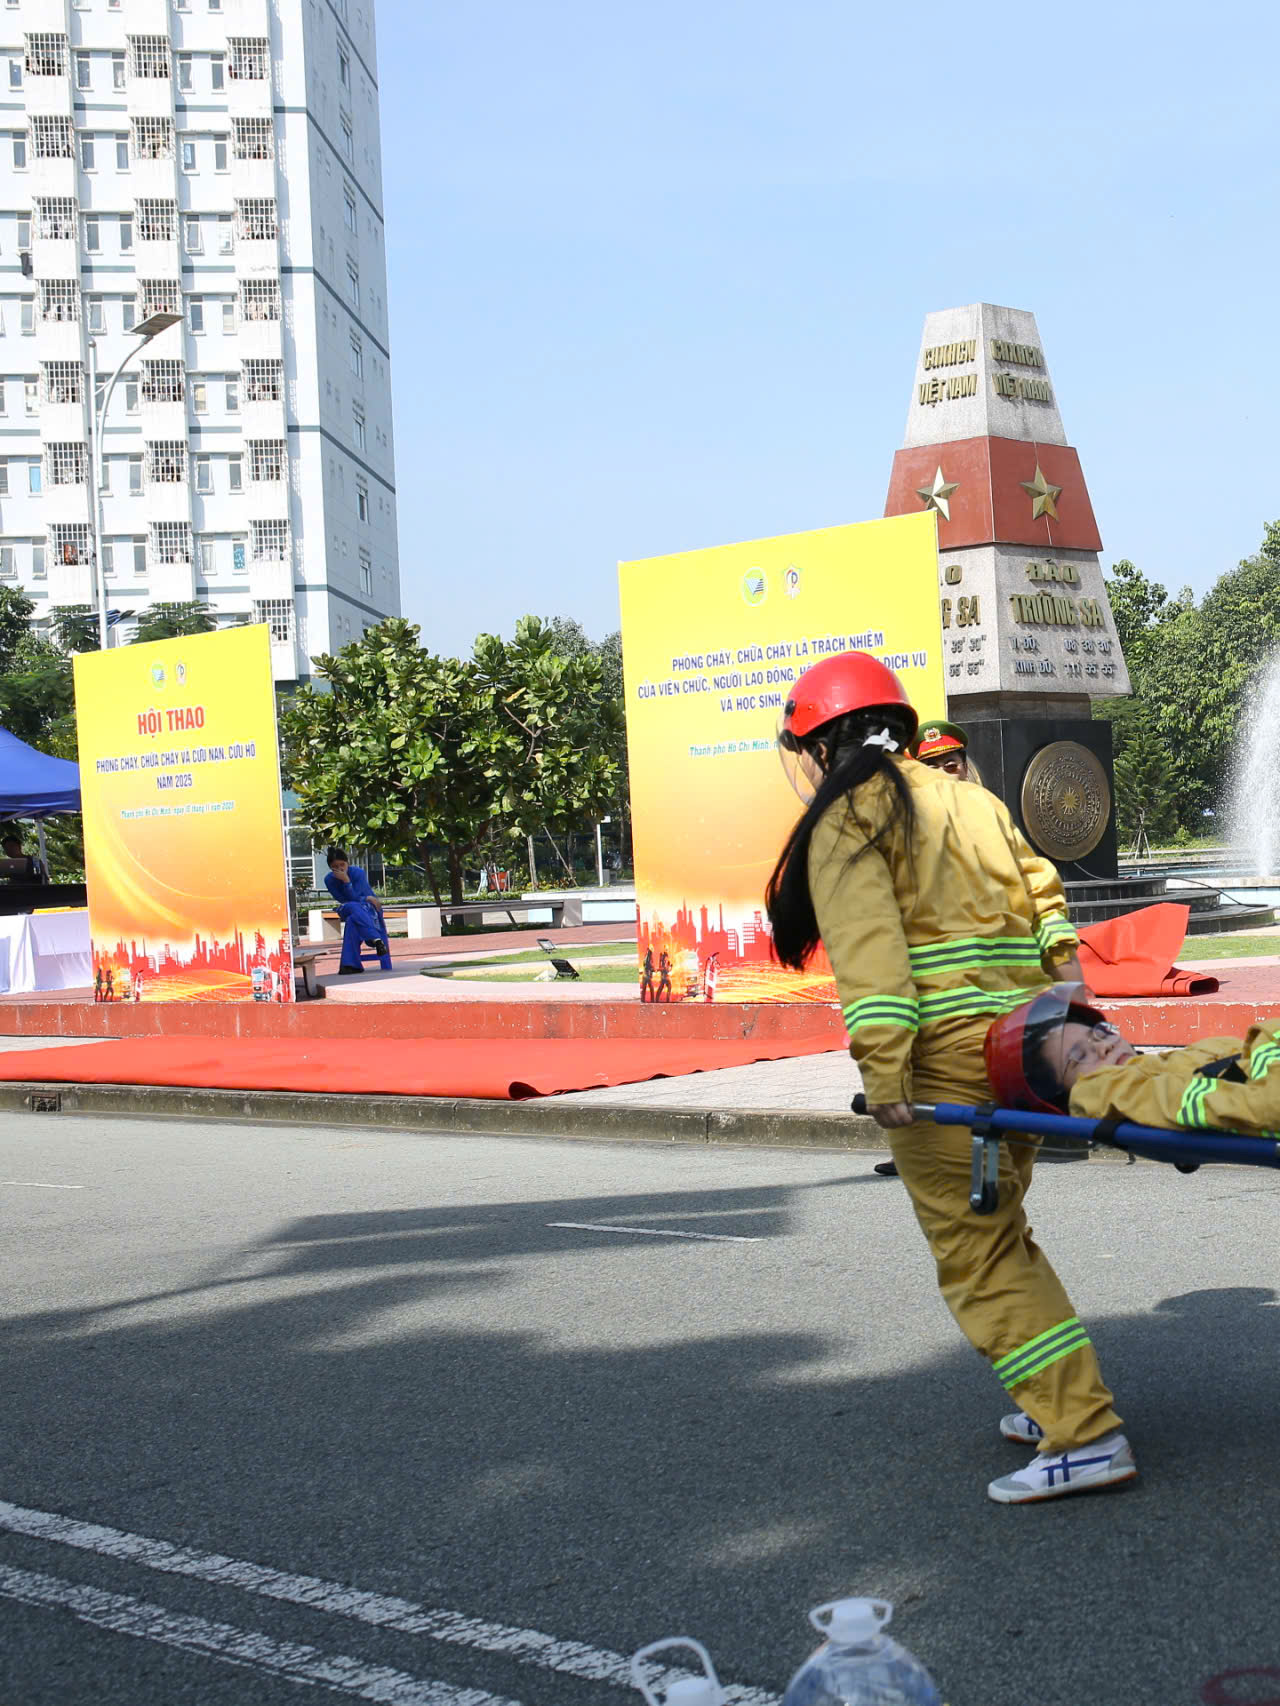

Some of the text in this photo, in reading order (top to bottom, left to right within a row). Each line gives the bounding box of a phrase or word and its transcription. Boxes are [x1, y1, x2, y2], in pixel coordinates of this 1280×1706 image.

[919, 374, 977, 408] VIỆT NAM
[992, 372, 1049, 402] VIỆT NAM
[1026, 559, 1080, 583] ĐẢO
[956, 595, 981, 627] SA
[1009, 590, 1105, 627] TRƯỜNG SA
[849, 630, 884, 651] NHIỆM
[659, 678, 680, 696] VIÊN
[713, 671, 742, 690] NGƯỜI
[745, 671, 763, 686] LAO
[736, 695, 756, 713] HỌC
[137, 706, 205, 739] HỘI THAO
[175, 774, 193, 788] 2025
